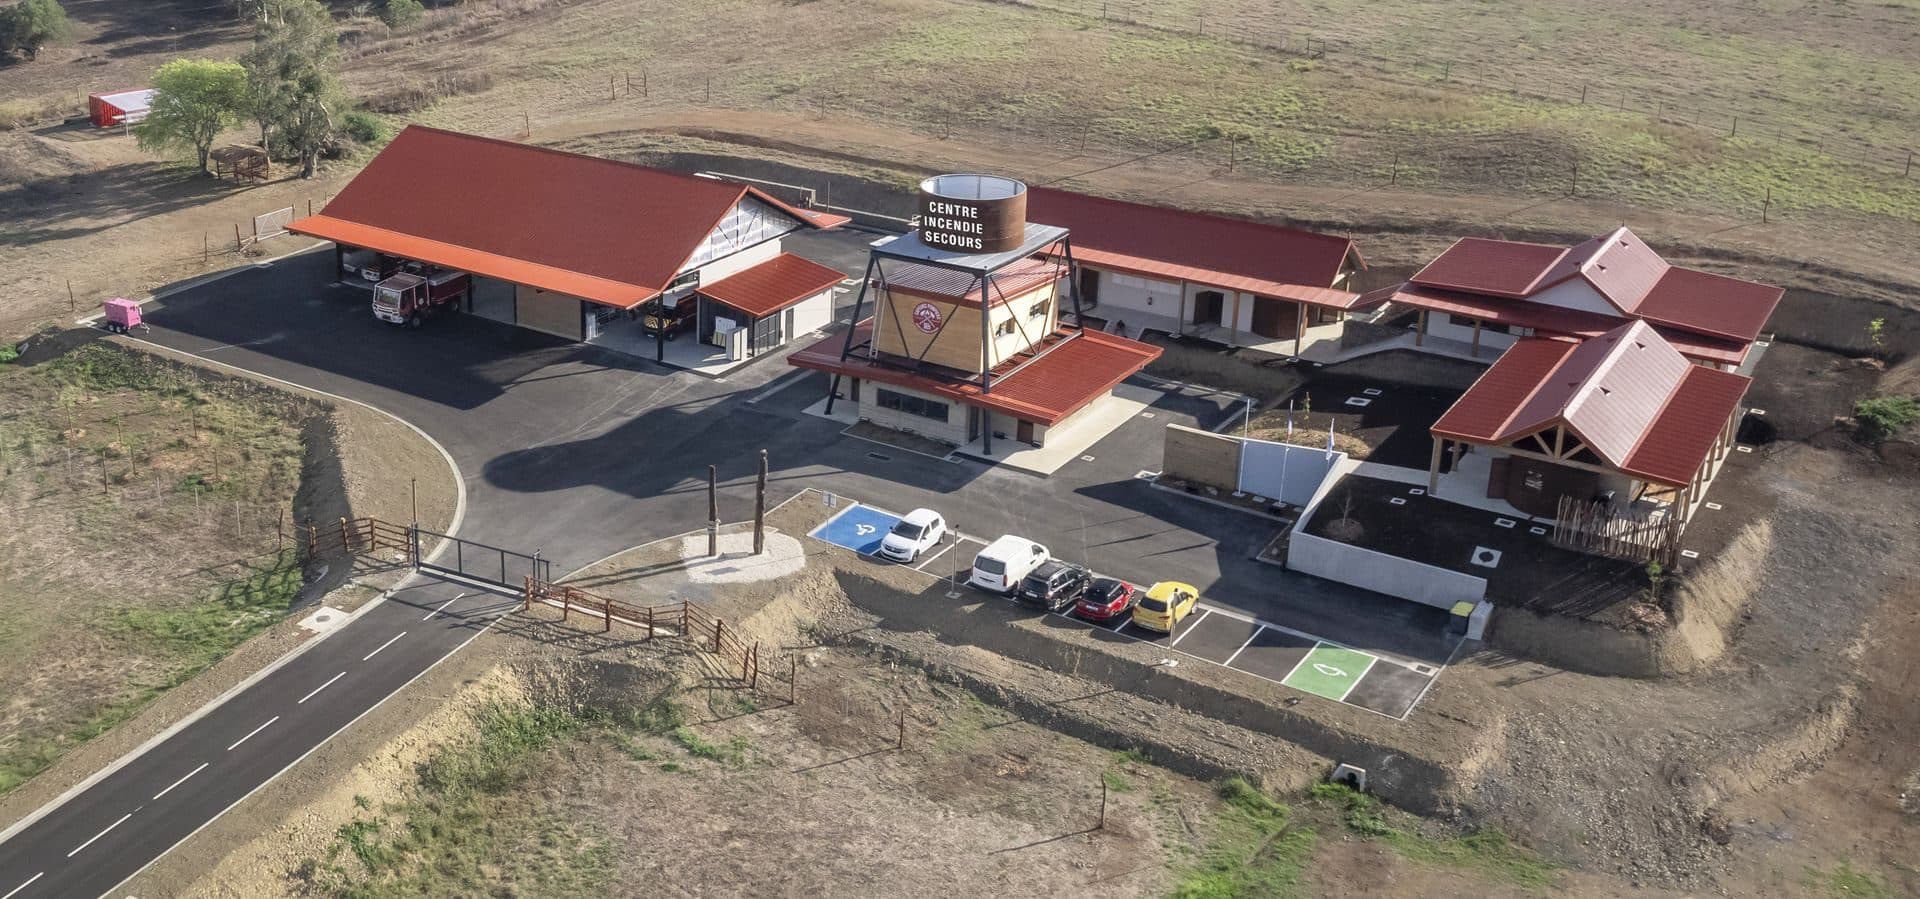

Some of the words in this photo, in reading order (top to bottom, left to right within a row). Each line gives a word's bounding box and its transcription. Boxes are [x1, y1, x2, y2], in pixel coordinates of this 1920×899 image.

[929, 201, 978, 219] CENTRE
[924, 215, 983, 234] INCENDIE
[925, 231, 983, 249] SECOURS
